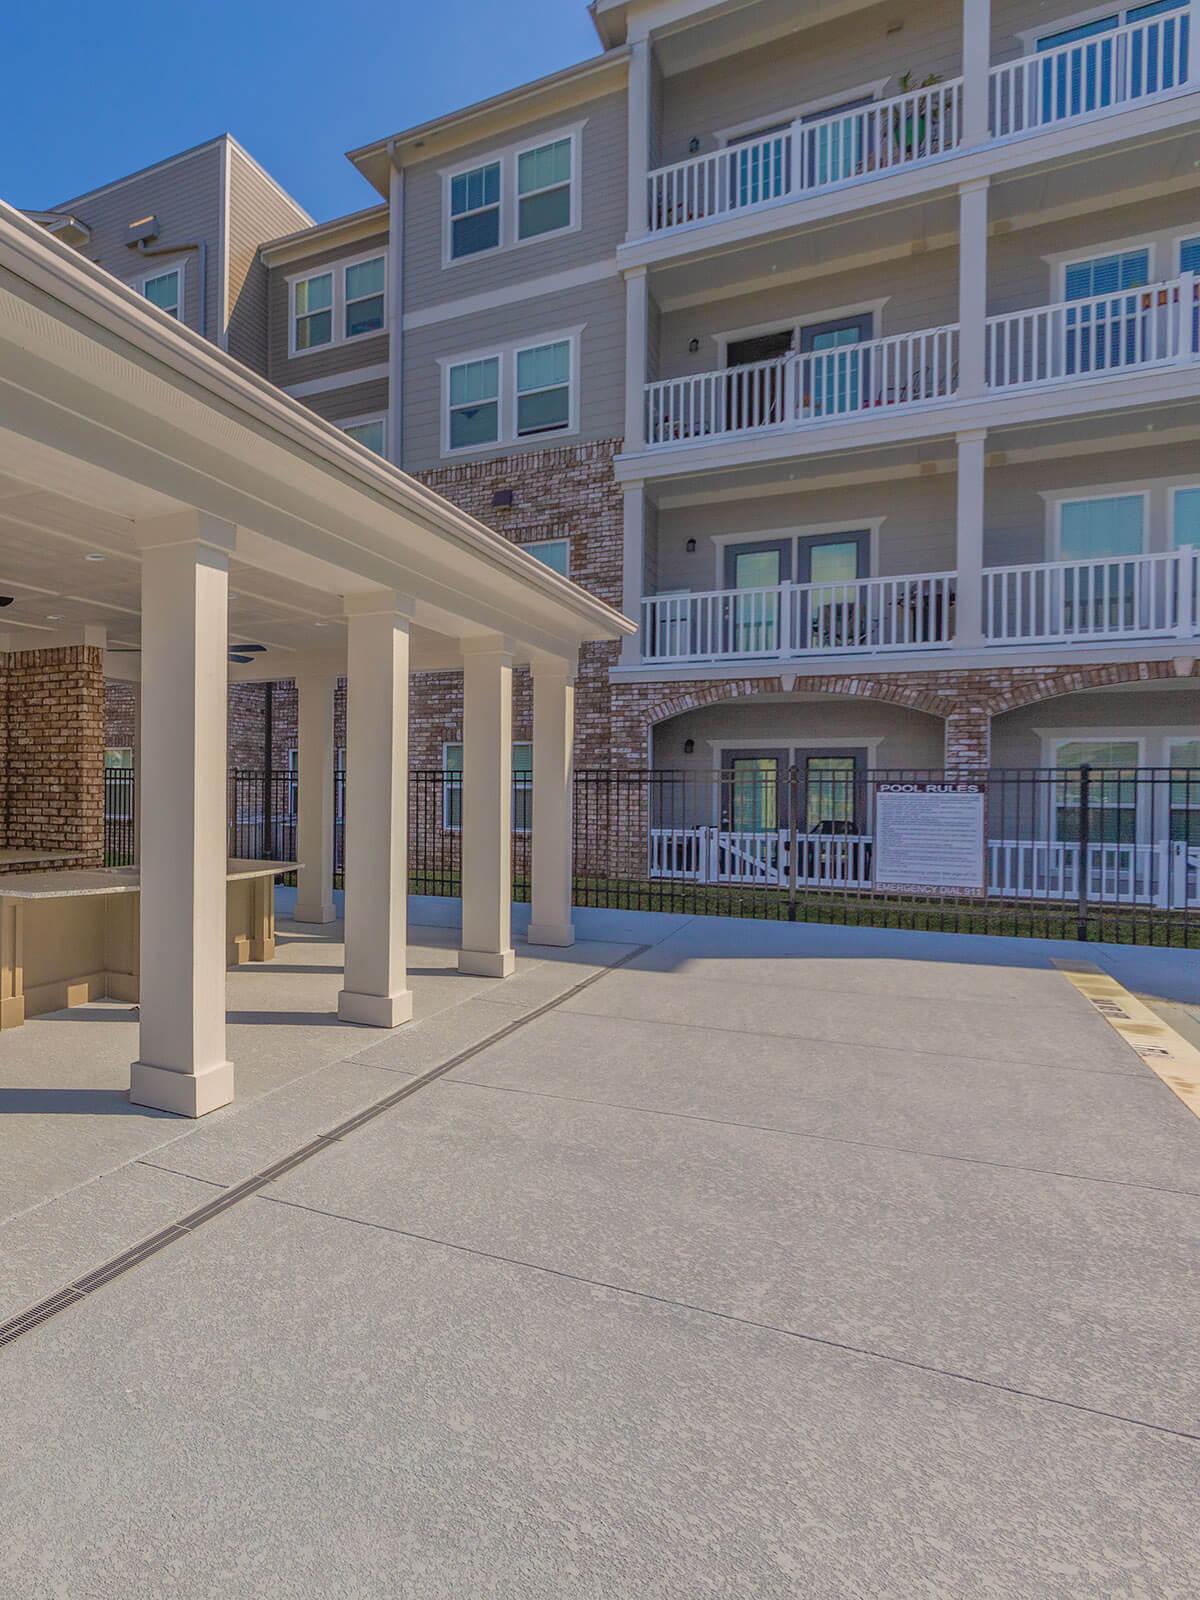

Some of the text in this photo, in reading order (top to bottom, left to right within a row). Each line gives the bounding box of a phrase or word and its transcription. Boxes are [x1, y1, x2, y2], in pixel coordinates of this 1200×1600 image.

[880, 784, 979, 793] POOL RULES
[876, 883, 981, 896] EMERGENCY DIAL 911
